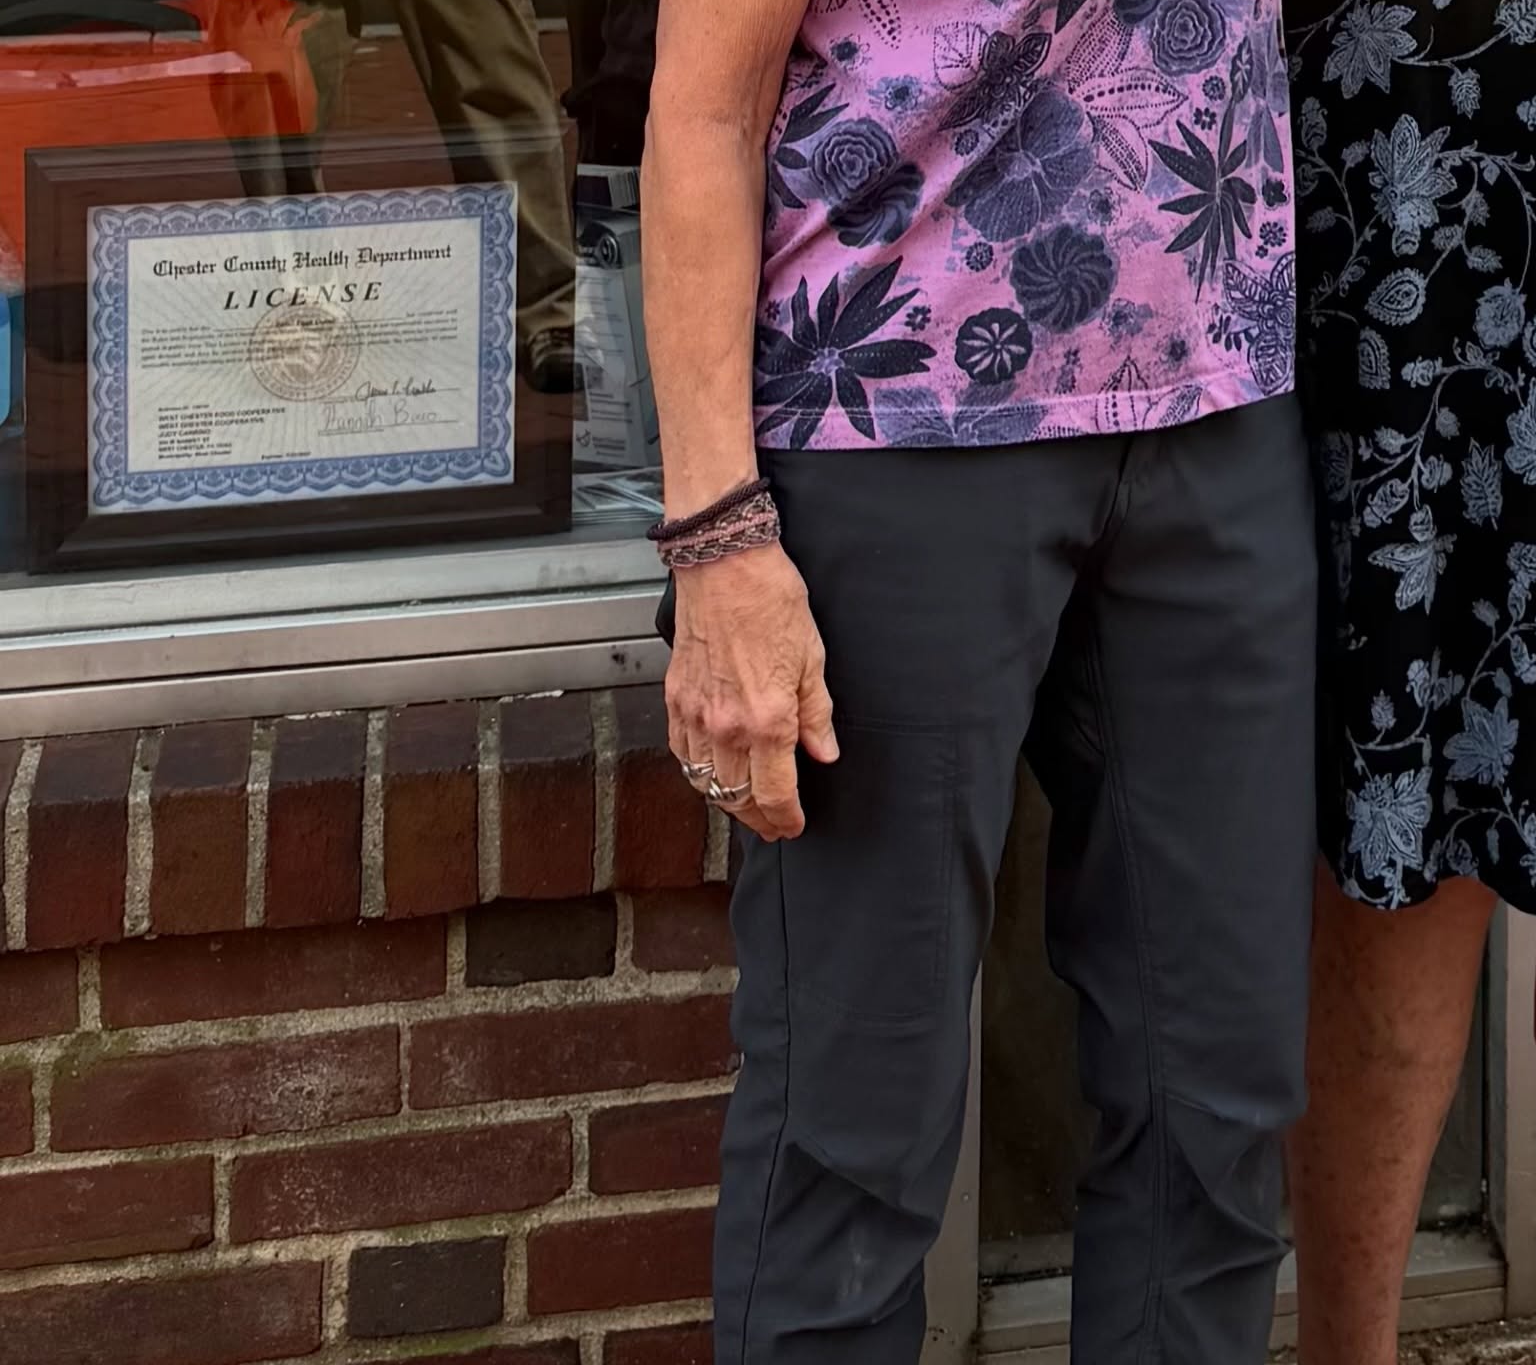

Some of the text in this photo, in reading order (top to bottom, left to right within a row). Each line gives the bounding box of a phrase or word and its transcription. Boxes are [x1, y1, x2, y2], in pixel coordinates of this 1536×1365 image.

[152, 244, 452, 280] Chester County Health Department
[223, 281, 383, 311] LICENSE
